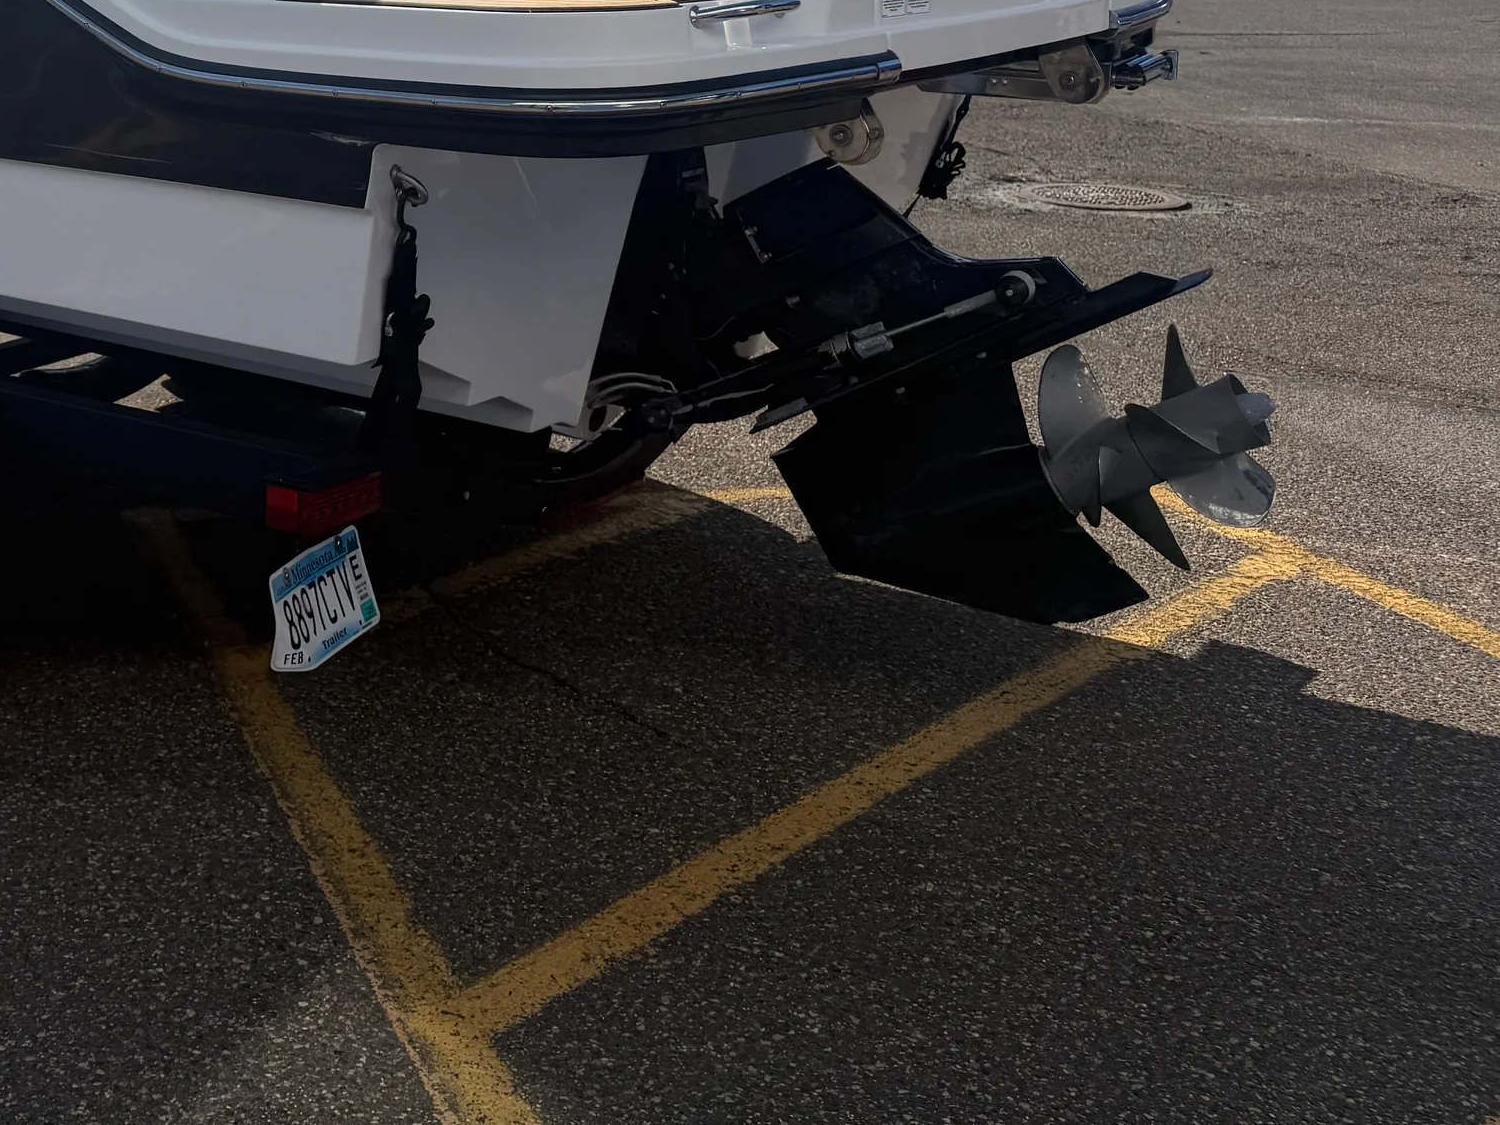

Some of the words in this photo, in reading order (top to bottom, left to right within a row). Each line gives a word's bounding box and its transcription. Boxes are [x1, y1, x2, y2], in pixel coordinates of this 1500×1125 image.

[290, 550, 334, 584] Minnesota
[321, 626, 349, 651] Trailer
[283, 651, 304, 665] FEB
